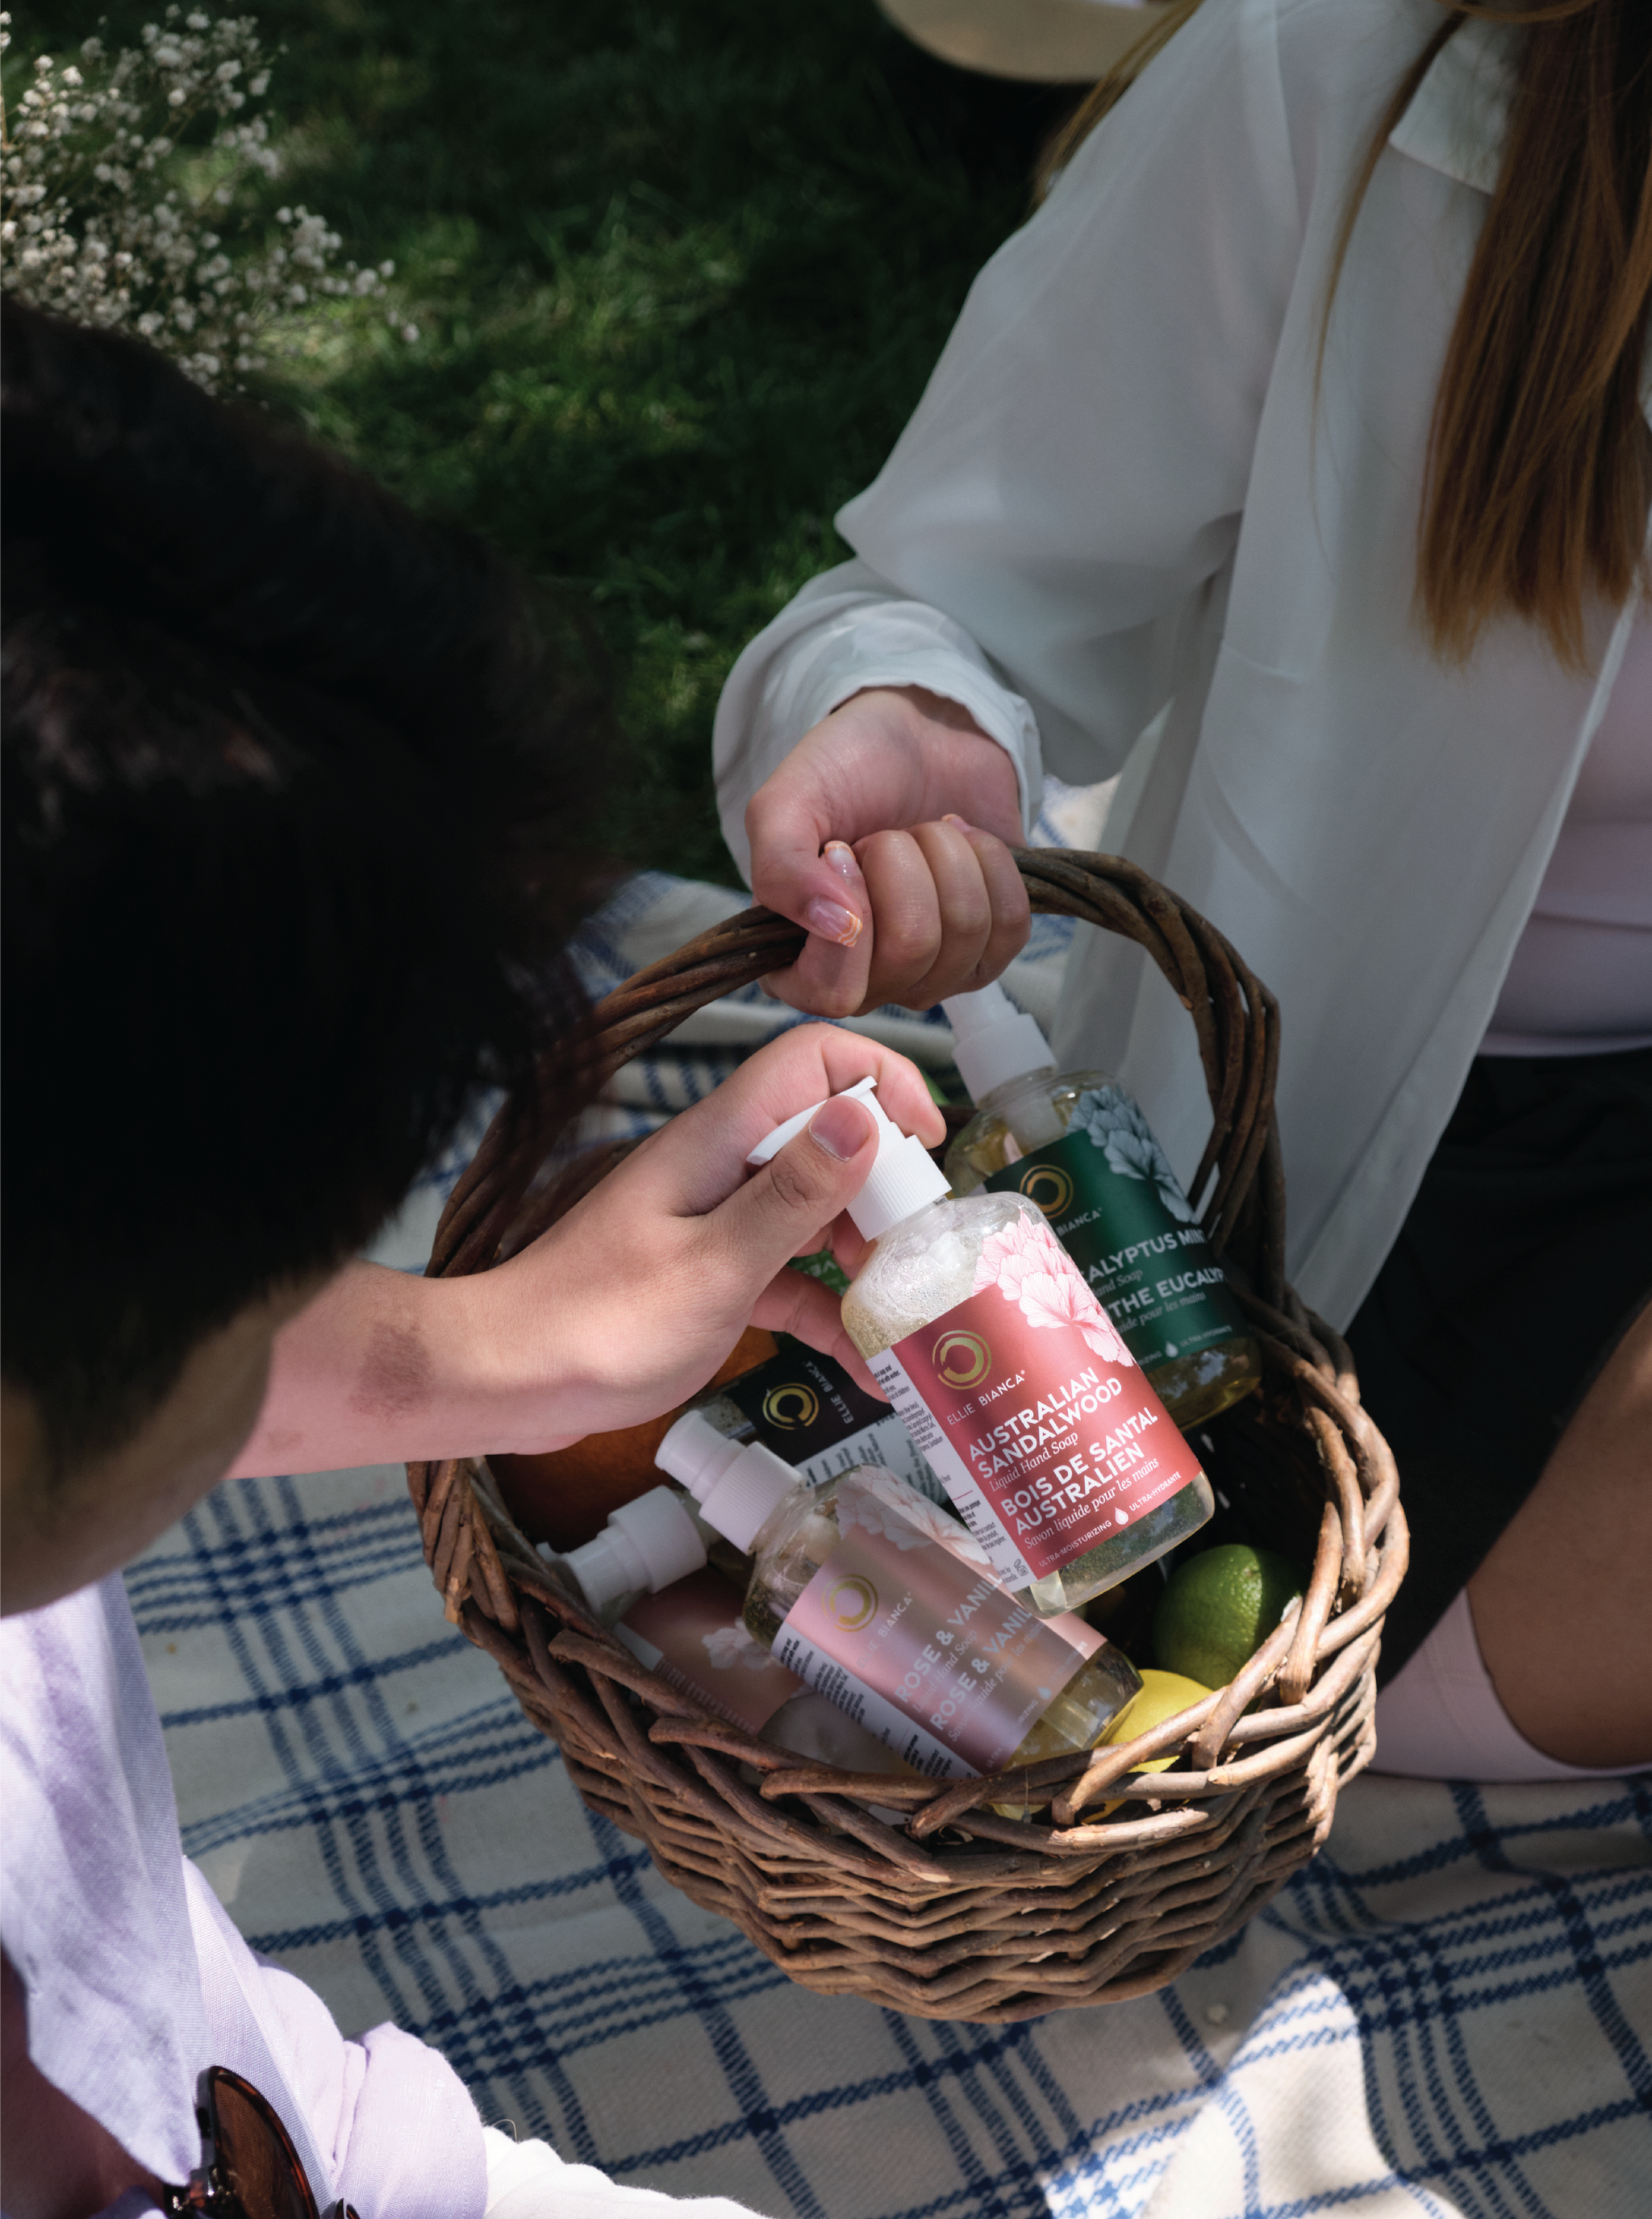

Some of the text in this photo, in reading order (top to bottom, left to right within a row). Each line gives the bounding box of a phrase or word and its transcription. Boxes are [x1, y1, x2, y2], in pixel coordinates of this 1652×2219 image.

[1081, 1233, 1178, 1283] ALYPTUS
[1116, 1268, 1143, 1287] Soap
[1104, 1287, 1155, 1324] THE
[1138, 1306, 1164, 1327] pour
[1164, 1300, 1179, 1313] les
[1179, 1291, 1206, 1308] mains
[805, 1361, 833, 1392] BIANCA
[830, 1394, 854, 1424] ELLIE
[946, 1403, 975, 1425] ELLIE
[969, 1366, 1099, 1462] AUSTRALIAN
[978, 1377, 1122, 1479] SANDALWOOD
[989, 1432, 1078, 1492] Liquid Hand Soap
[1000, 1407, 1158, 1517] BOIS DE SANTAL
[1015, 1441, 1145, 1536] AUSTRALIEN
[1024, 1525, 1054, 1550] Savon
[1053, 1502, 1091, 1533] liquide
[1091, 1485, 1116, 1513] pour
[1116, 1474, 1132, 1492] les
[1131, 1458, 1159, 1482] mains
[1128, 1470, 1182, 1512] ULTRA-HYDRANTE
[1038, 1519, 1112, 1568] ULTRA-MOISTURIZING
[857, 1596, 913, 1668] ELLIE BIANCA
[894, 1644, 941, 1703] ROSE
[936, 1629, 954, 1645] &
[947, 1572, 1003, 1626] VANILL
[912, 1682, 937, 1713] Liquid
[935, 1654, 959, 1686] Hand
[955, 1629, 978, 1654] Soap
[930, 1671, 977, 1730] ROSE
[971, 1658, 990, 1674] &
[982, 1608, 1032, 1655] VANIL
[995, 1655, 1014, 1683] pour
[1011, 1641, 1026, 1658] les
